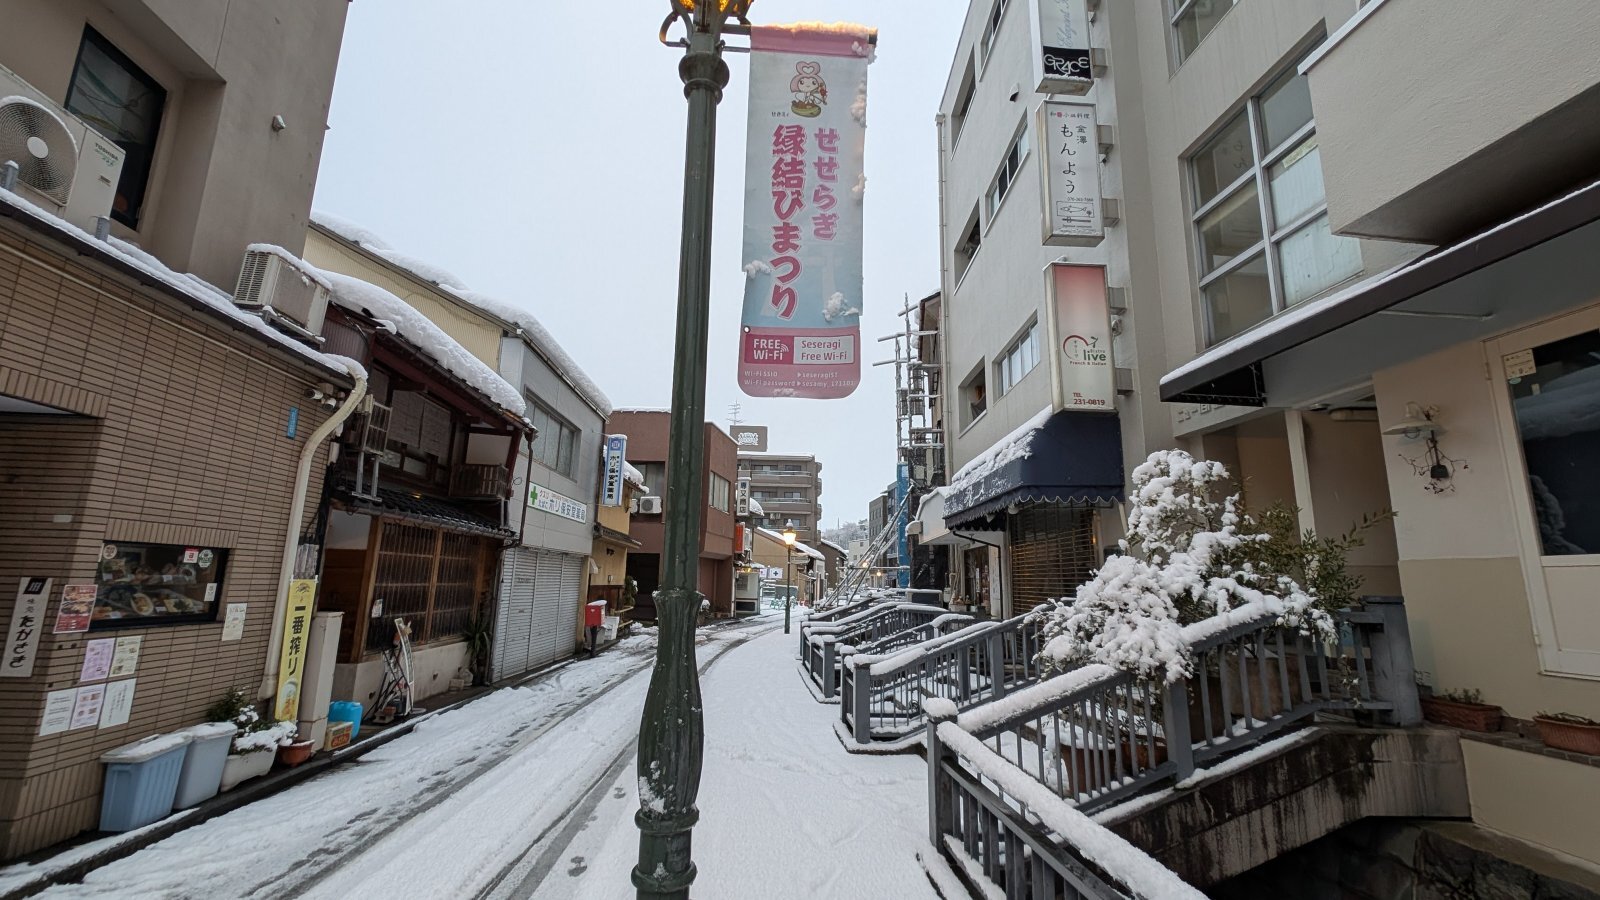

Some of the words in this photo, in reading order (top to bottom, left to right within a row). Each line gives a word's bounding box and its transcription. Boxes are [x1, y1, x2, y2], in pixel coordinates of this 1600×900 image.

[1044, 54, 1089, 75] GRACE
[95, 142, 119, 161] TOSHIBA
[1060, 124, 1077, 194] もんよう
[811, 127, 840, 241] せせらぎ
[769, 124, 807, 320] 縁結びまつり
[753, 338, 781, 349] FREE
[801, 339, 841, 350] Seseragi
[753, 349, 784, 361] Wi-Fi
[801, 352, 821, 361] Free
[823, 350, 848, 361] Wi-Fi
[1073, 398, 1106, 406] 231-0819
[9, 615, 35, 669] たかさき
[288, 605, 307, 677] 一番搾り
